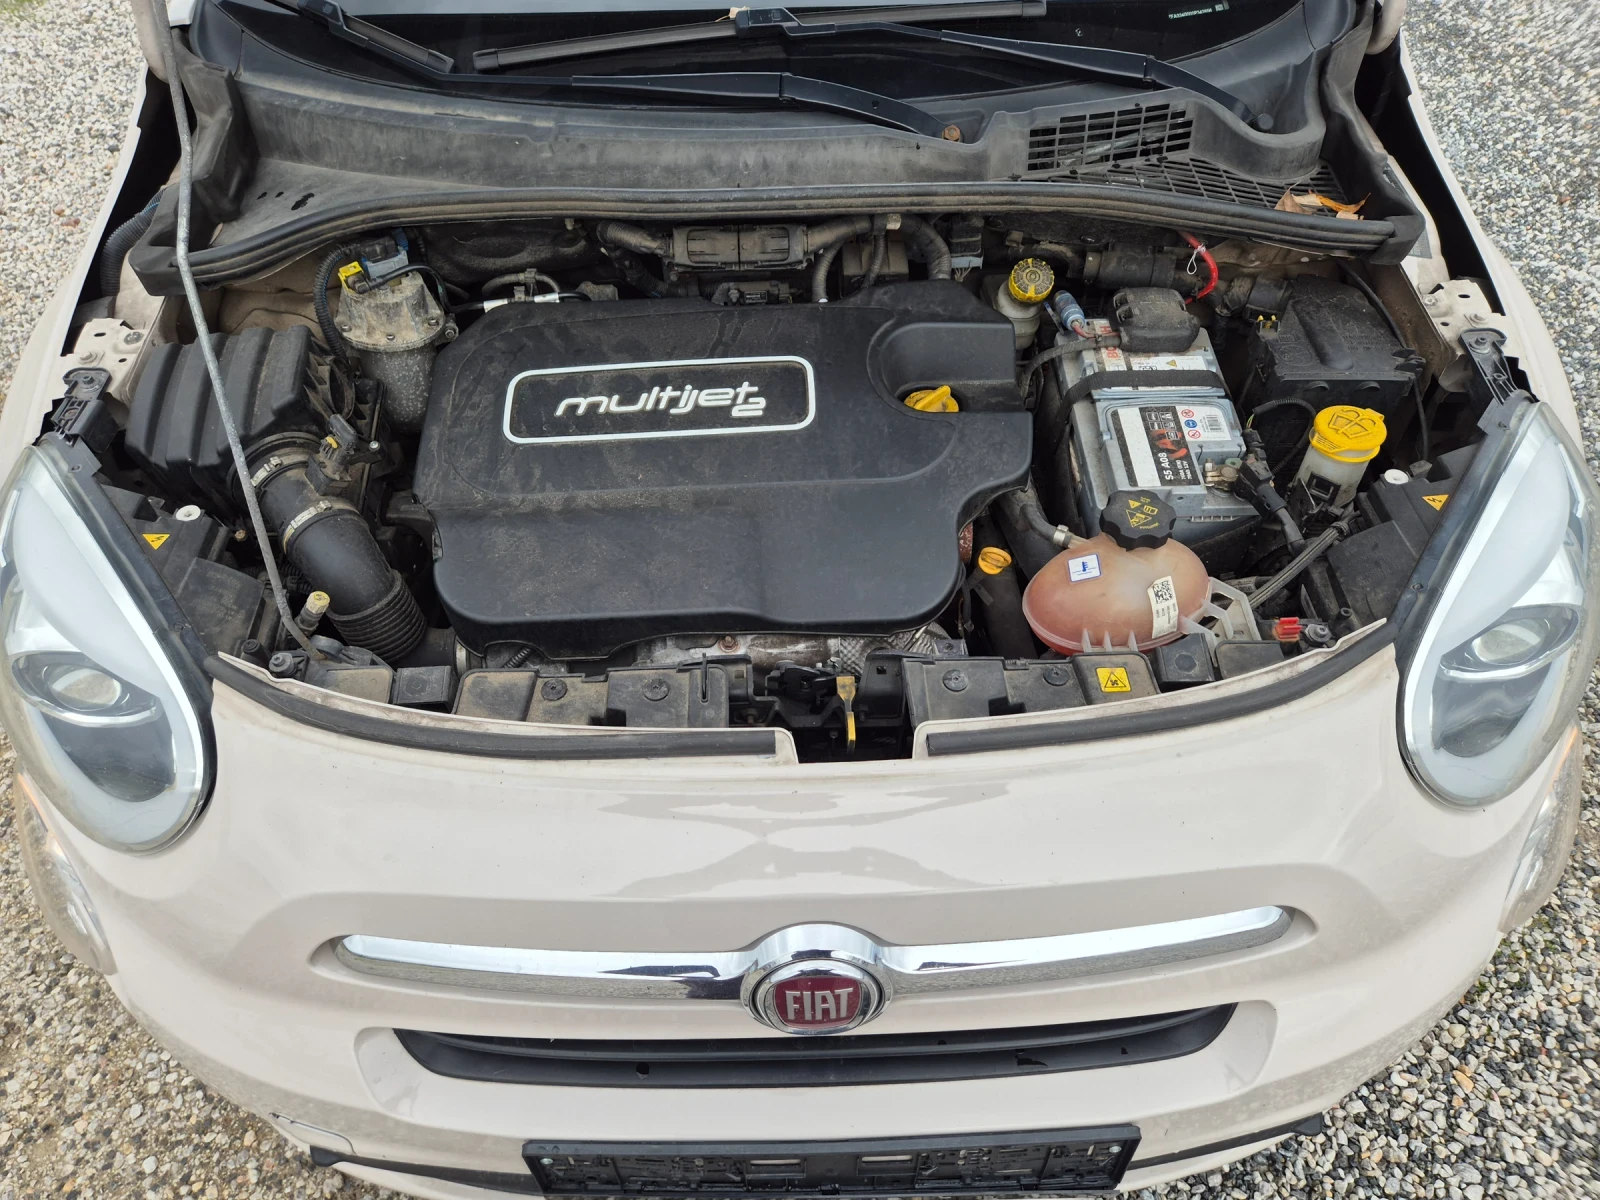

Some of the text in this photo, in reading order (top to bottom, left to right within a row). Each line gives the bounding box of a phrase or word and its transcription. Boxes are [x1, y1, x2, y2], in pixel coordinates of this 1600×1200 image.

[1158, 453, 1174, 480] S5 A08
[785, 987, 854, 1021] FIAT
